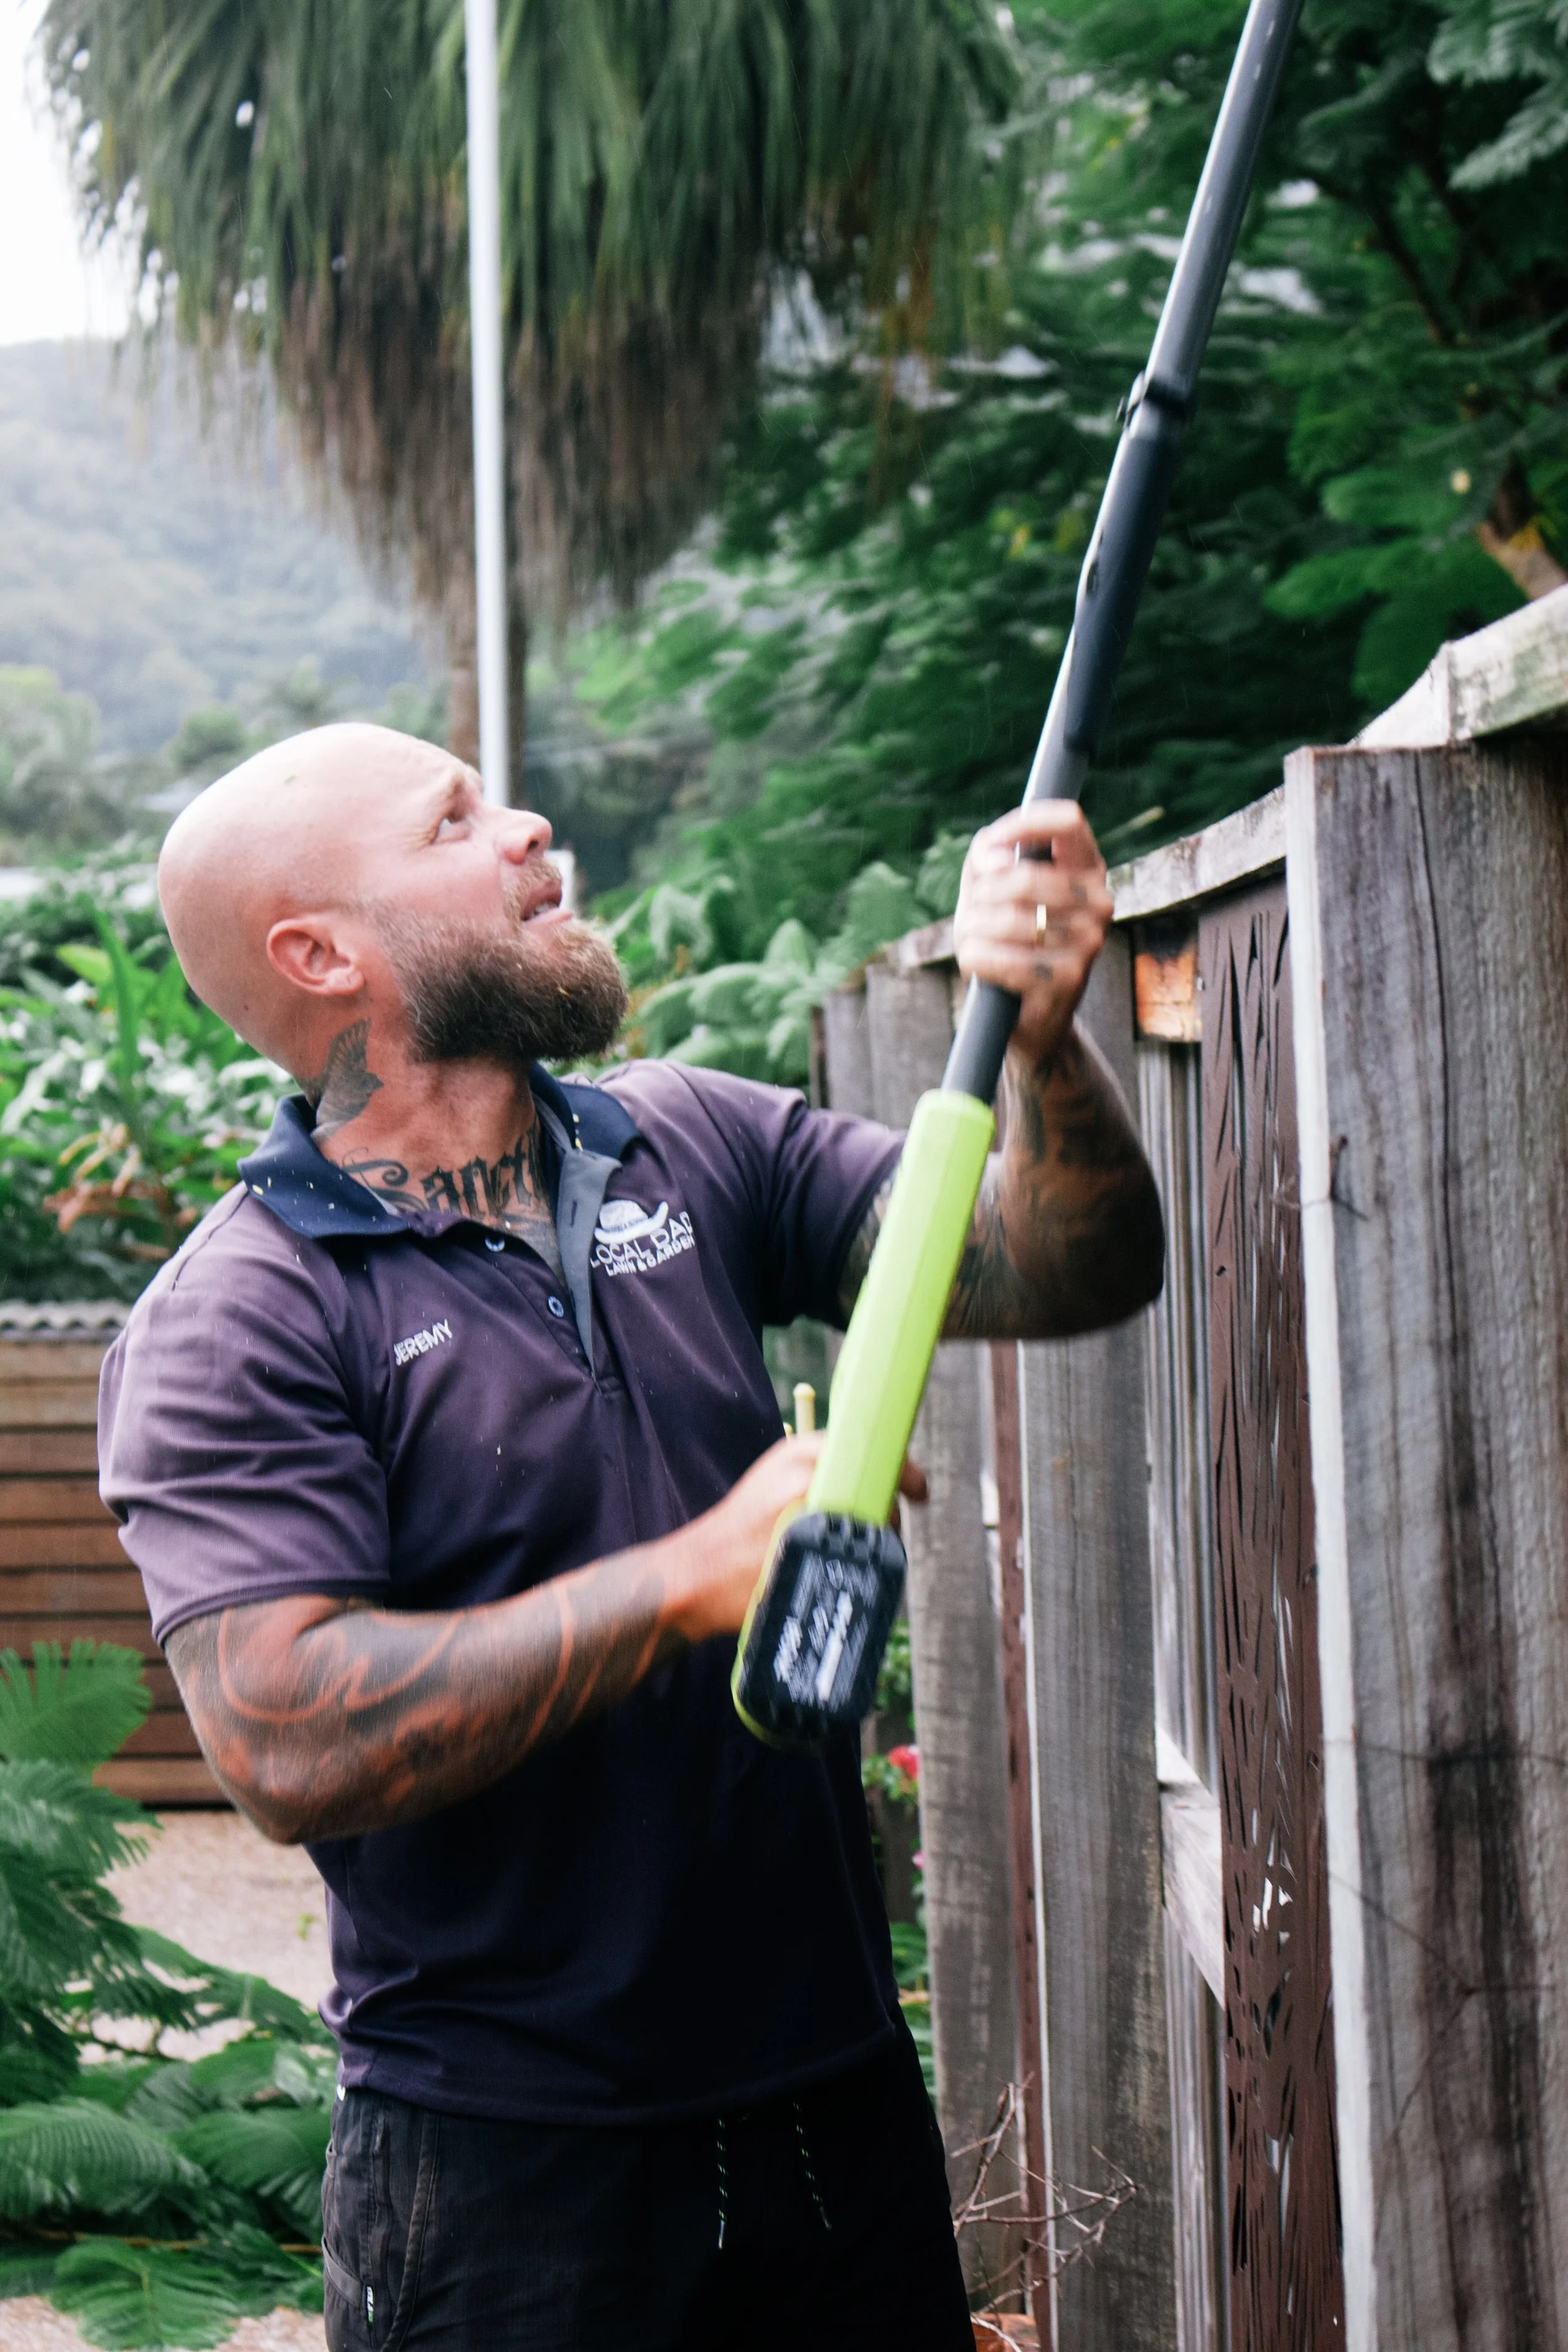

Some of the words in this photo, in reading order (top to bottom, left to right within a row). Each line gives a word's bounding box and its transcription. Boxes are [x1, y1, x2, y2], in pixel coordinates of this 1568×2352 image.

[590, 1238, 651, 1268] LOCAL
[605, 1258, 637, 1276] LAWN
[637, 1258, 647, 1272] &
[646, 1233, 695, 1268] GARDEN
[393, 1318, 452, 1366] JEREMY
